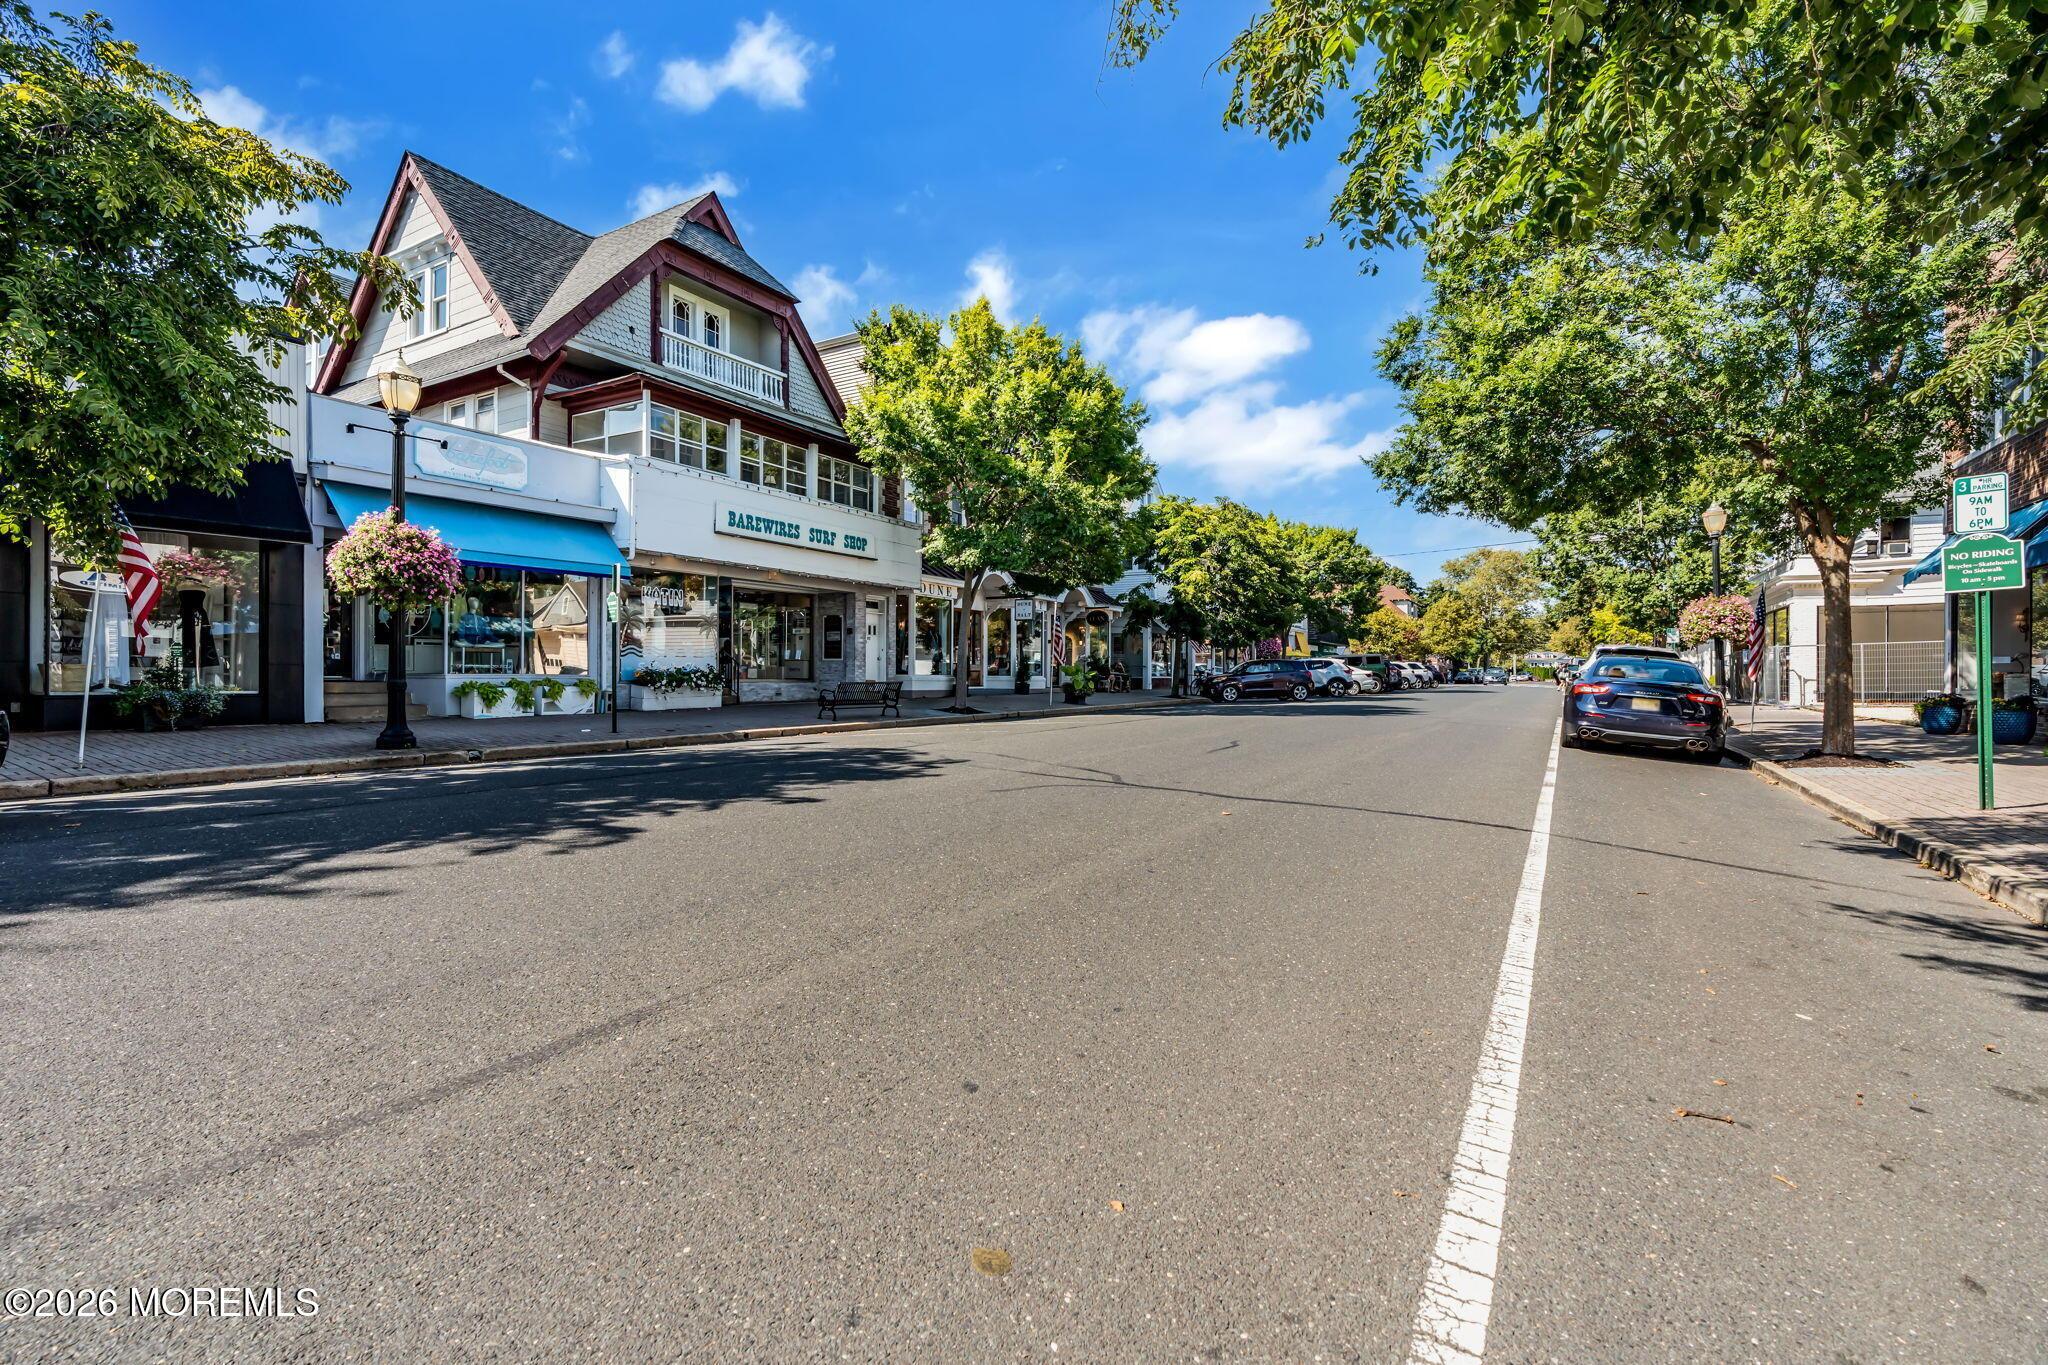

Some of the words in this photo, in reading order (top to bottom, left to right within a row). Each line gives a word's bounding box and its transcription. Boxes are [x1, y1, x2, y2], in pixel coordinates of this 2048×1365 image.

[1959, 482, 1967, 492] 3
[1972, 483, 2003, 491] PARKING
[1969, 495, 1993, 505] 9AM
[1975, 507, 1987, 516] TO
[1969, 518, 1993, 528] 6PM
[728, 511, 800, 539] BAREWIRES
[809, 528, 837, 546] SURF
[843, 534, 868, 551] SHOP
[1972, 548, 2014, 559] RIDING
[1974, 566, 2003, 574] Sidewalk
